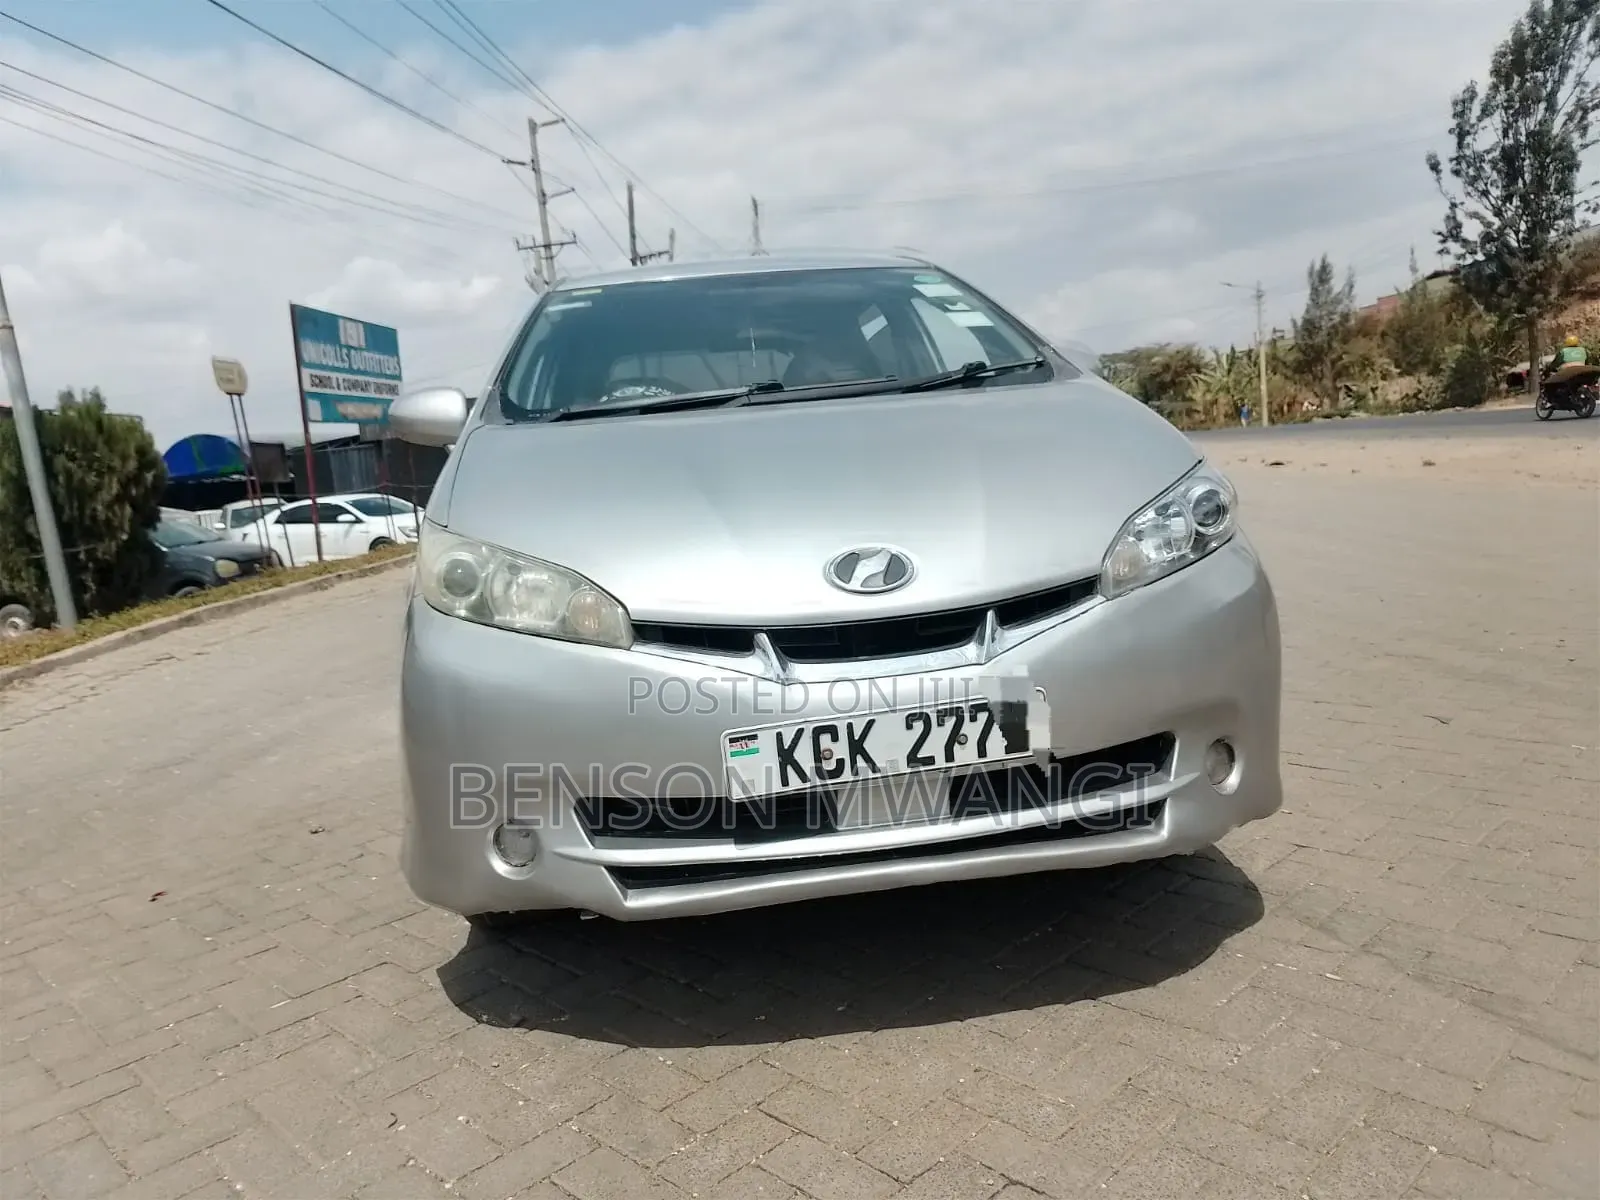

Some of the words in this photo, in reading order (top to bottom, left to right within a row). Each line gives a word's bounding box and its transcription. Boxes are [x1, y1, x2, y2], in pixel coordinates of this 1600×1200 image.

[350, 349, 400, 375] OUTFITTERS
[310, 374, 336, 390] SCHOOL
[342, 378, 373, 393] COMPANY
[775, 717, 881, 788] KCK
[905, 701, 1031, 769] 277
